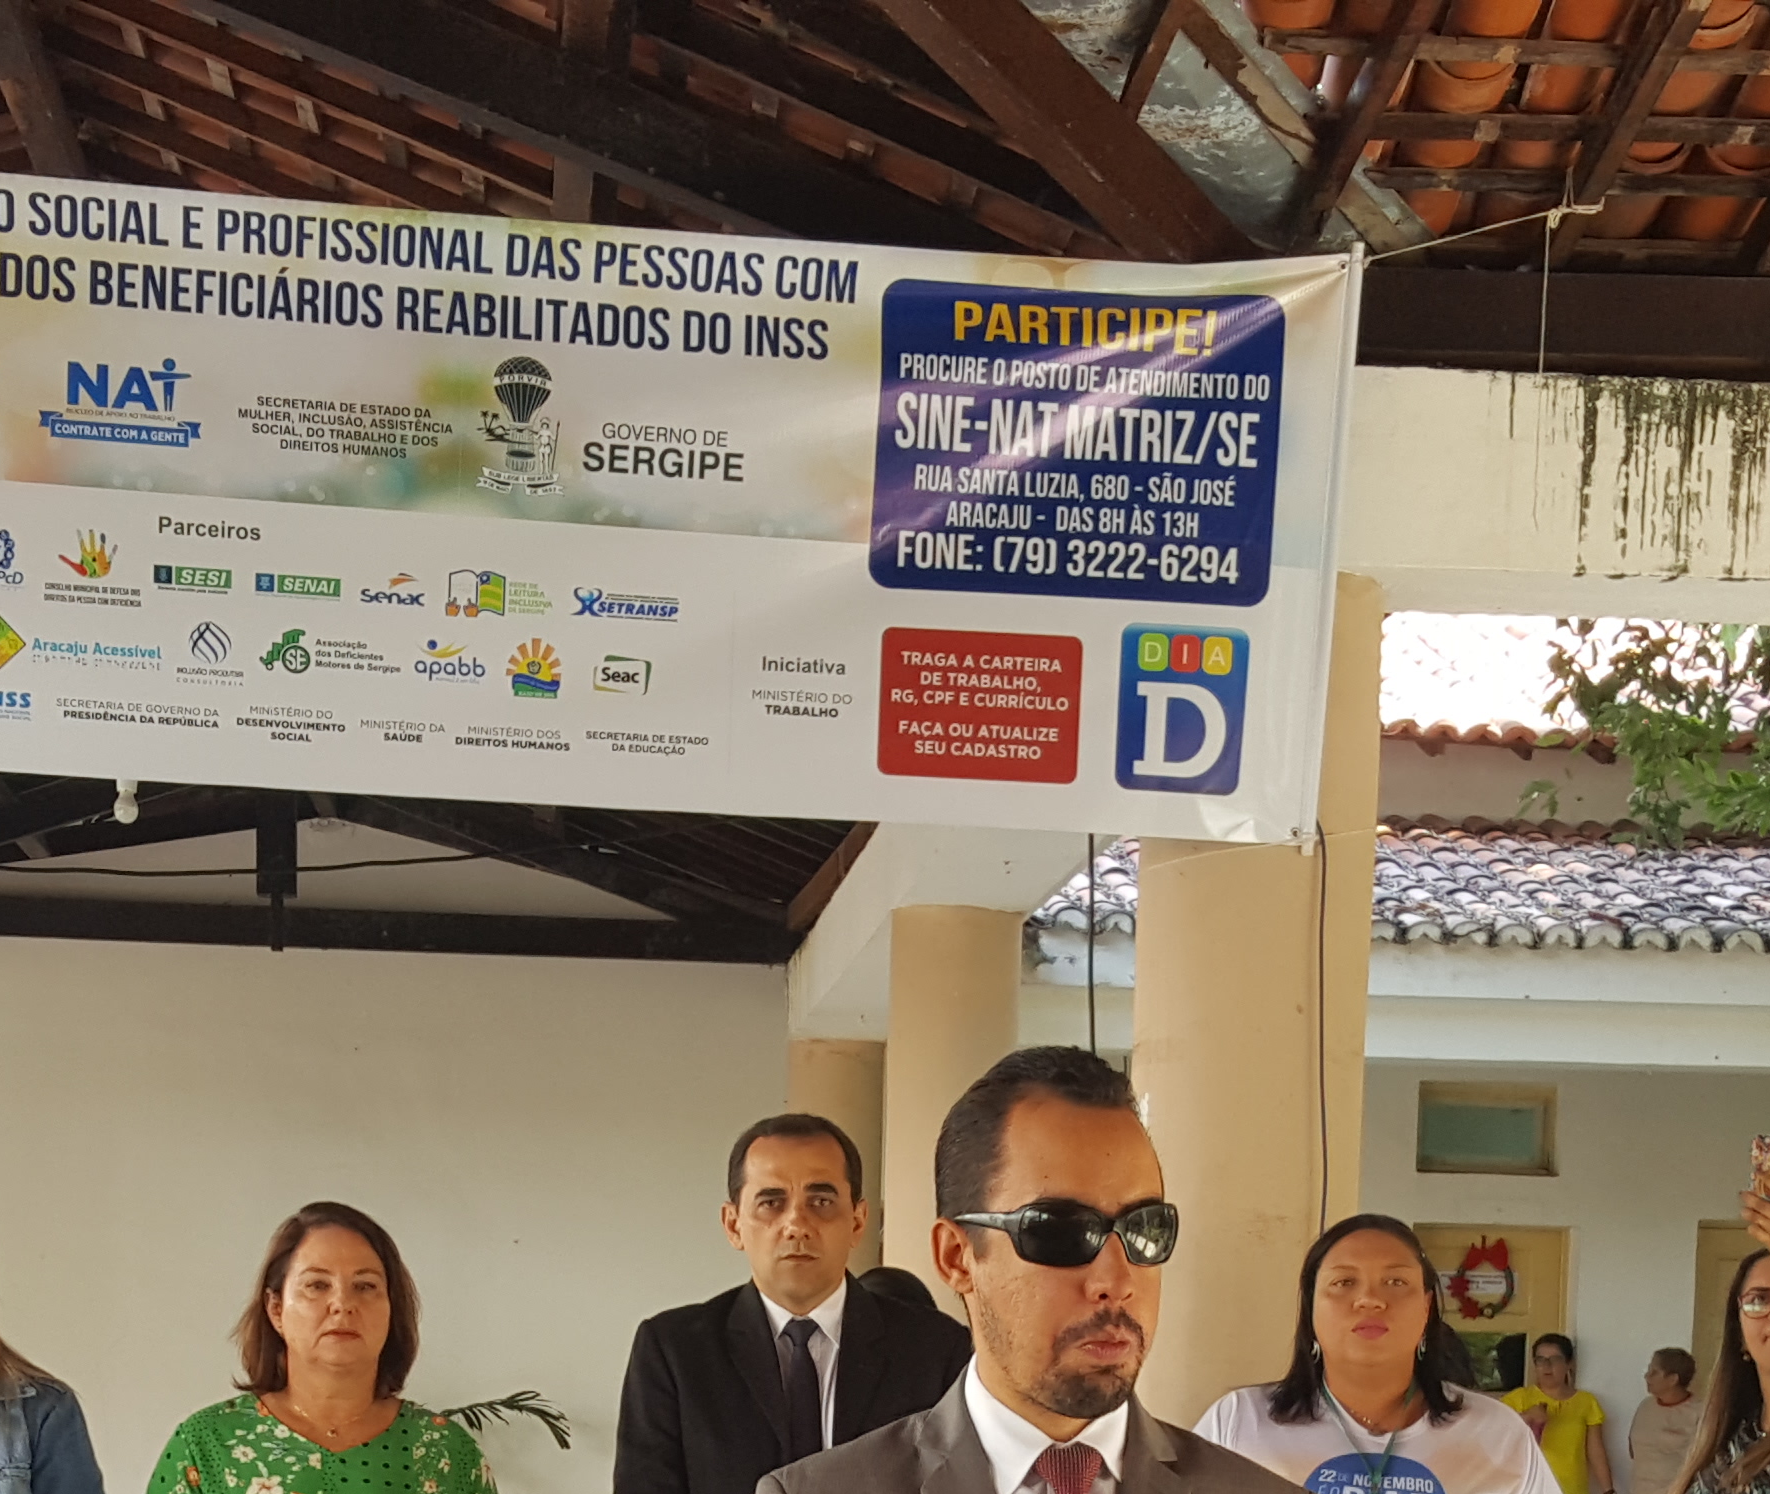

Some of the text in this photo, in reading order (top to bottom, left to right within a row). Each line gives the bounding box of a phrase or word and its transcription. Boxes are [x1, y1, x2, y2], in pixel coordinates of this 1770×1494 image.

[26, 191, 170, 248] SOCIAL
[181, 204, 206, 250] E
[216, 207, 494, 275] PROFISSIONAL
[504, 232, 582, 285] DAS
[593, 241, 765, 297] PESSOAS
[774, 254, 860, 304] COM
[88, 258, 384, 330] BENEFICIÁRIOS
[395, 283, 670, 353] REABILITADOS
[682, 308, 732, 355] DO
[743, 313, 830, 361] INSS
[953, 299, 1218, 357] PARTICIPE!
[899, 352, 1271, 402] PROCURE O POSTO DE ATENDIMENTO DO
[257, 396, 431, 418] SECRETARIA DE ESTADO DA
[238, 408, 453, 434] MULHER, INCLUSÃO, ASSISTÊNCIA
[894, 391, 1261, 469] SINE-NAT MATRIZ/SE
[55, 423, 186, 443] CONTRATE COM A GENTE
[252, 423, 439, 447] SOCIAL, DO TRABALHO E DOS
[601, 422, 729, 448] GOVERNO DE
[280, 439, 407, 459] DIREITOS HUMANOS
[581, 441, 745, 482] SERGIPE
[913, 463, 1237, 507] RUA SANTA LUZIA, 680 SÃO JOSÉ
[157, 515, 262, 541] Parceiros
[945, 500, 1199, 539] ARACAJU DAS 8H ÀS 13H
[895, 529, 1240, 585] FONE: (79) 3222-6294
[178, 568, 228, 587] SESI
[282, 577, 336, 595] SENAI
[597, 600, 679, 618] SETRANSP
[32, 638, 162, 660] Aracaju Acessível
[1143, 639, 1227, 668] DIA
[414, 656, 486, 681] apabb
[761, 655, 846, 675] Iniciativa
[901, 650, 1063, 673] TRAGA A CARTEIRA
[600, 666, 640, 684] Seac
[920, 671, 1042, 693] DE TRABALHO,
[56, 697, 220, 717] SECRETARIA DE GOVERNO DA
[751, 688, 854, 706] MINISTÉRIO DO
[890, 688, 1070, 712] RG, CPF E CURRÍCULO
[63, 709, 220, 729] PRESIDÊNCIA DA REPÚBLICA
[249, 704, 334, 720] MINISTÉRIO DO
[764, 704, 839, 719] TRABALHO
[236, 717, 346, 733] DESENVOLVIMENTO
[360, 719, 446, 733] MINISTÉRIO DA
[467, 725, 562, 739] MINISTÉRIO DOS
[898, 720, 1060, 742] FAÇA OU ATUALIZE
[1132, 679, 1229, 778] D
[270, 731, 312, 743] SOCIAL
[383, 730, 423, 743] SAÚDE
[455, 736, 571, 752] DIREITOS HUMANOS
[913, 739, 1043, 760] SEU CADASTRO
[1318, 1468, 1337, 1483] 22
